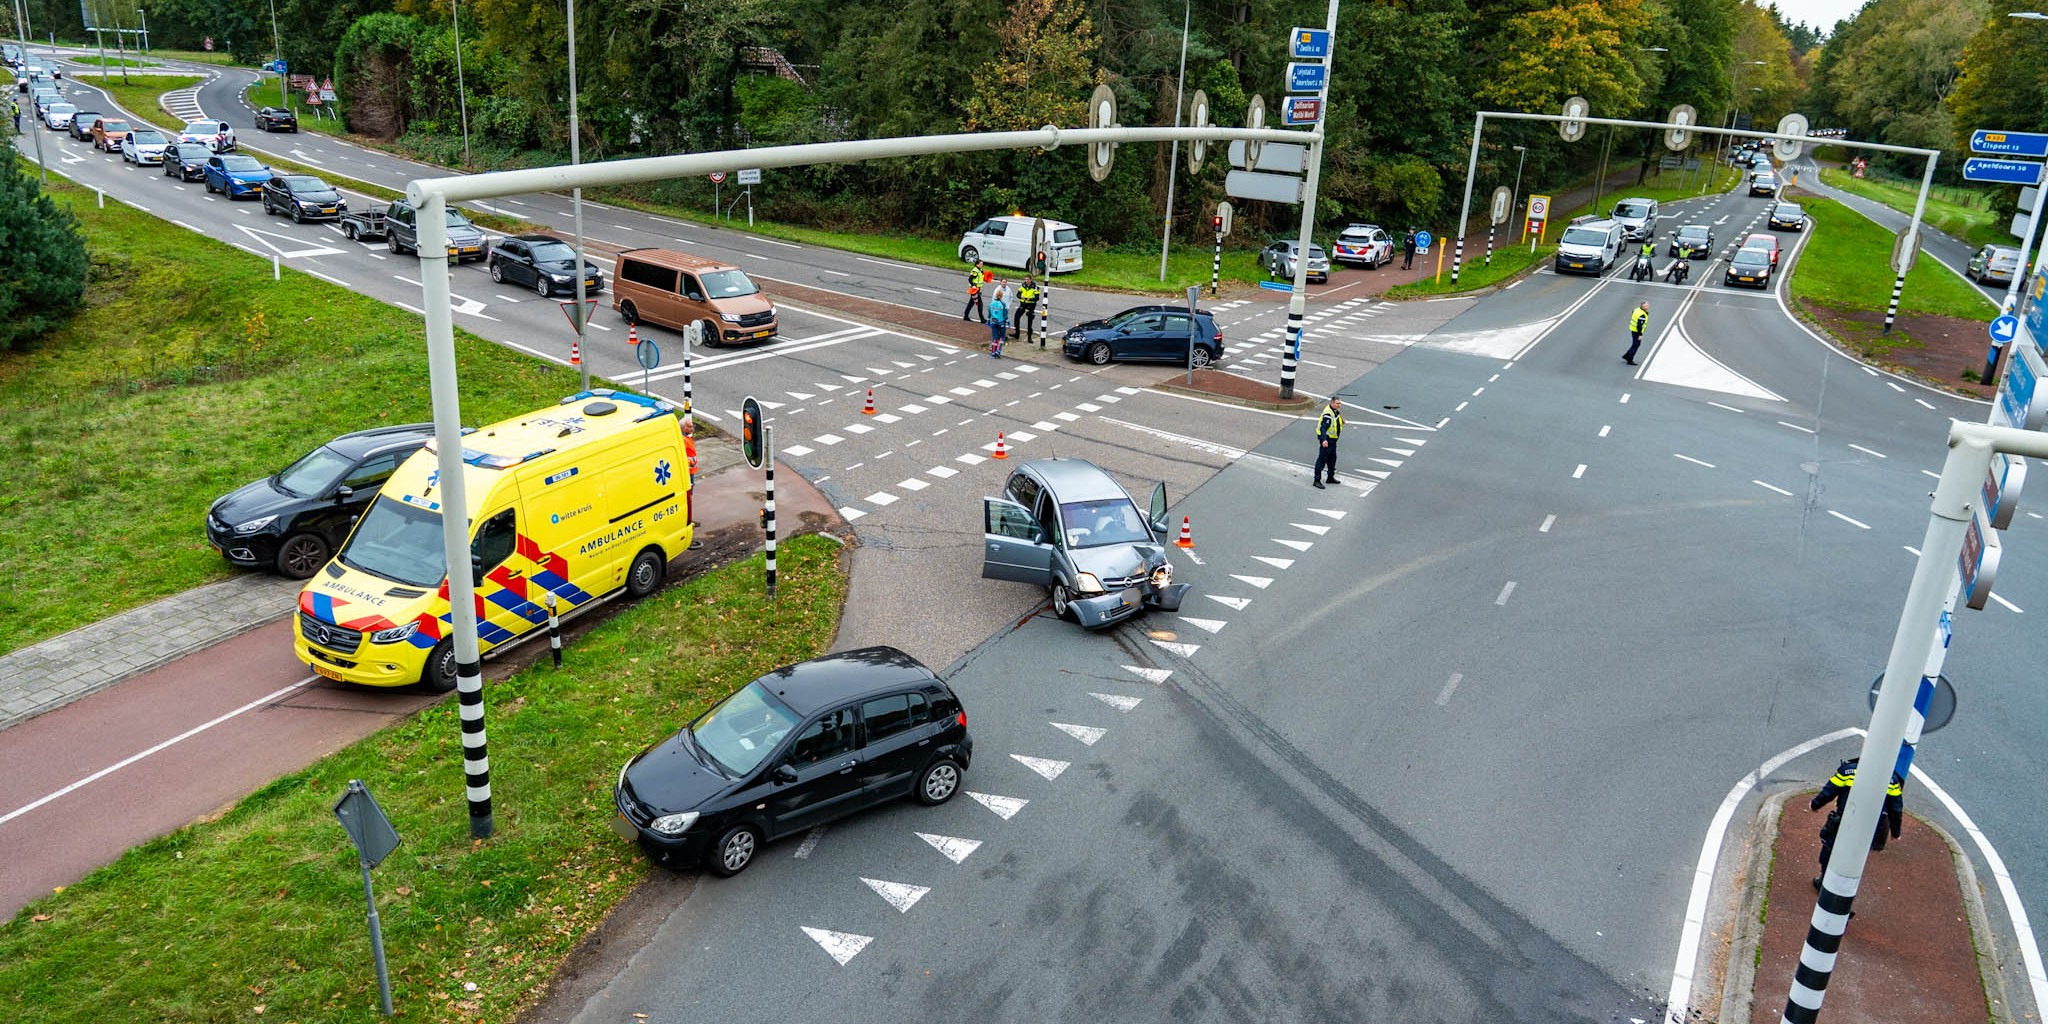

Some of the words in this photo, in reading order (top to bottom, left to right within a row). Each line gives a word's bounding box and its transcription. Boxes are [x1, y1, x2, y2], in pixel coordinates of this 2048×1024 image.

[1977, 162, 2016, 170] Apeldoorn
[560, 509, 577, 521] witte
[577, 504, 593, 515] kruis
[653, 504, 679, 521] 06-181
[579, 519, 644, 555] AMBULANCE
[321, 581, 387, 607] AMBULANCE
